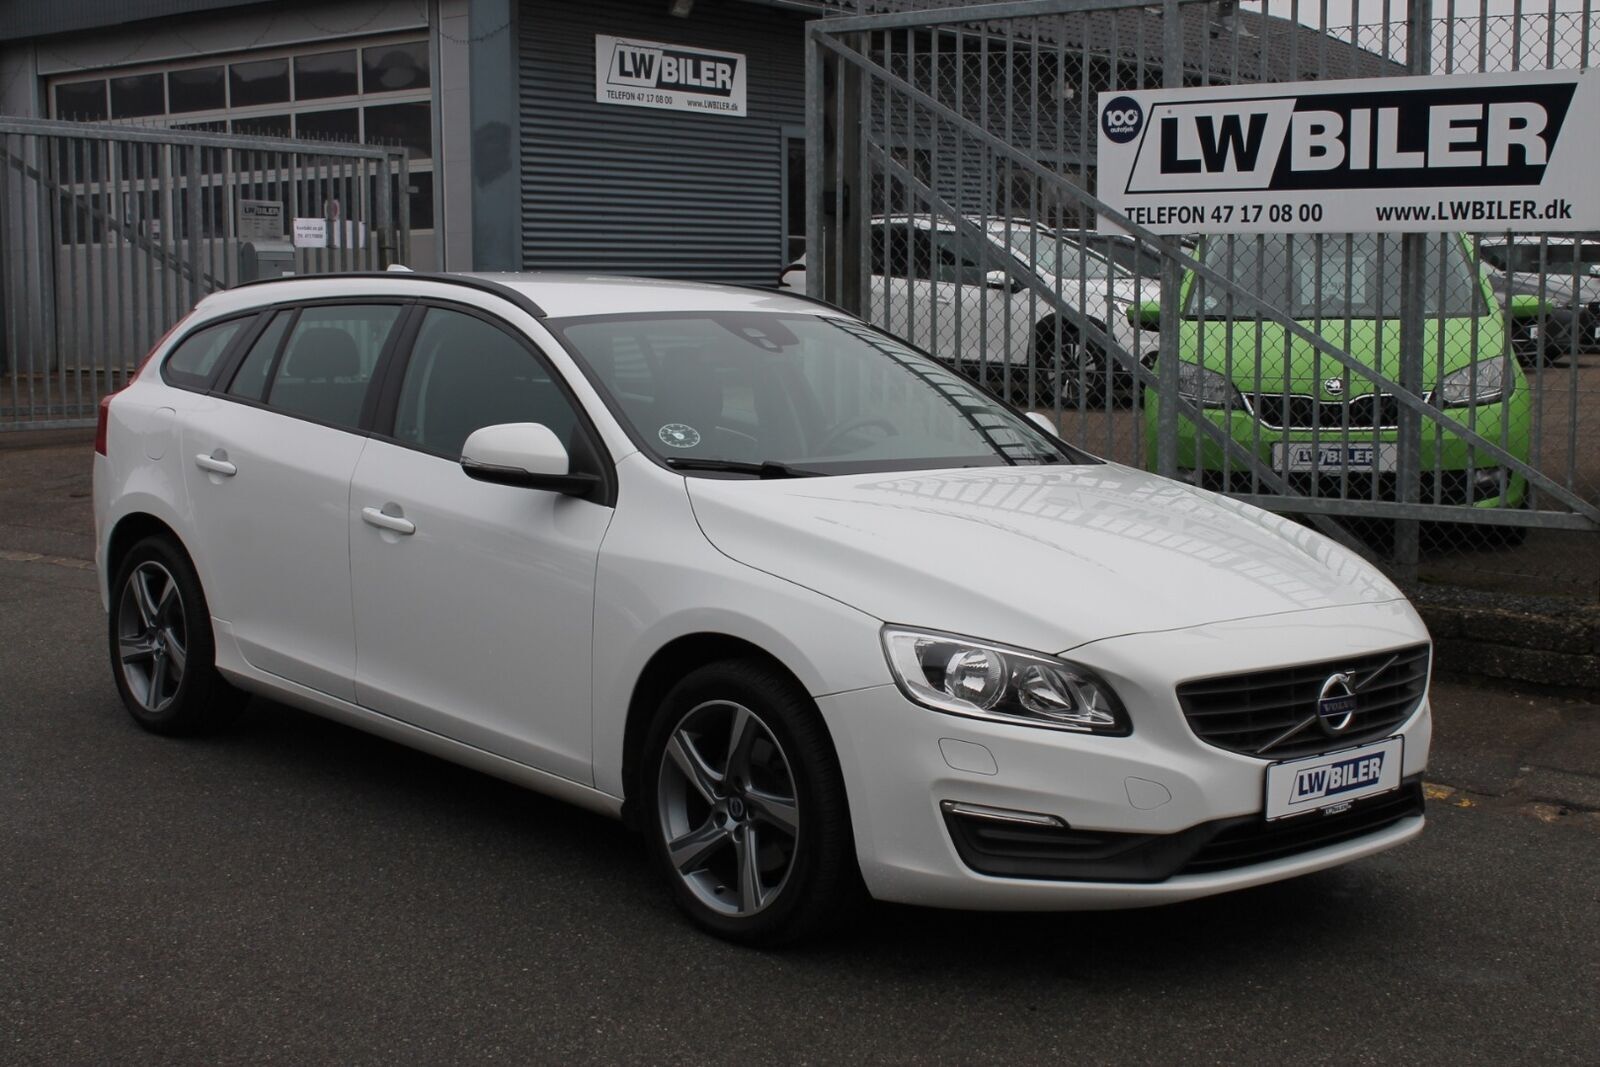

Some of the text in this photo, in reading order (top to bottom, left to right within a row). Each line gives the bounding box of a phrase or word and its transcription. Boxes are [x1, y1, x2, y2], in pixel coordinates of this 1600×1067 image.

[619, 50, 732, 90] LW BILER
[606, 90, 673, 105] TELEFON 47 17 08 00
[687, 99, 739, 112] www.LWBILER.dk
[1160, 102, 1548, 175] LW BILER
[1124, 203, 1323, 225] TELEFON 47 17 08 00
[1375, 199, 1572, 221] www.LWBILER.dk
[1297, 757, 1381, 797] LW BILER
